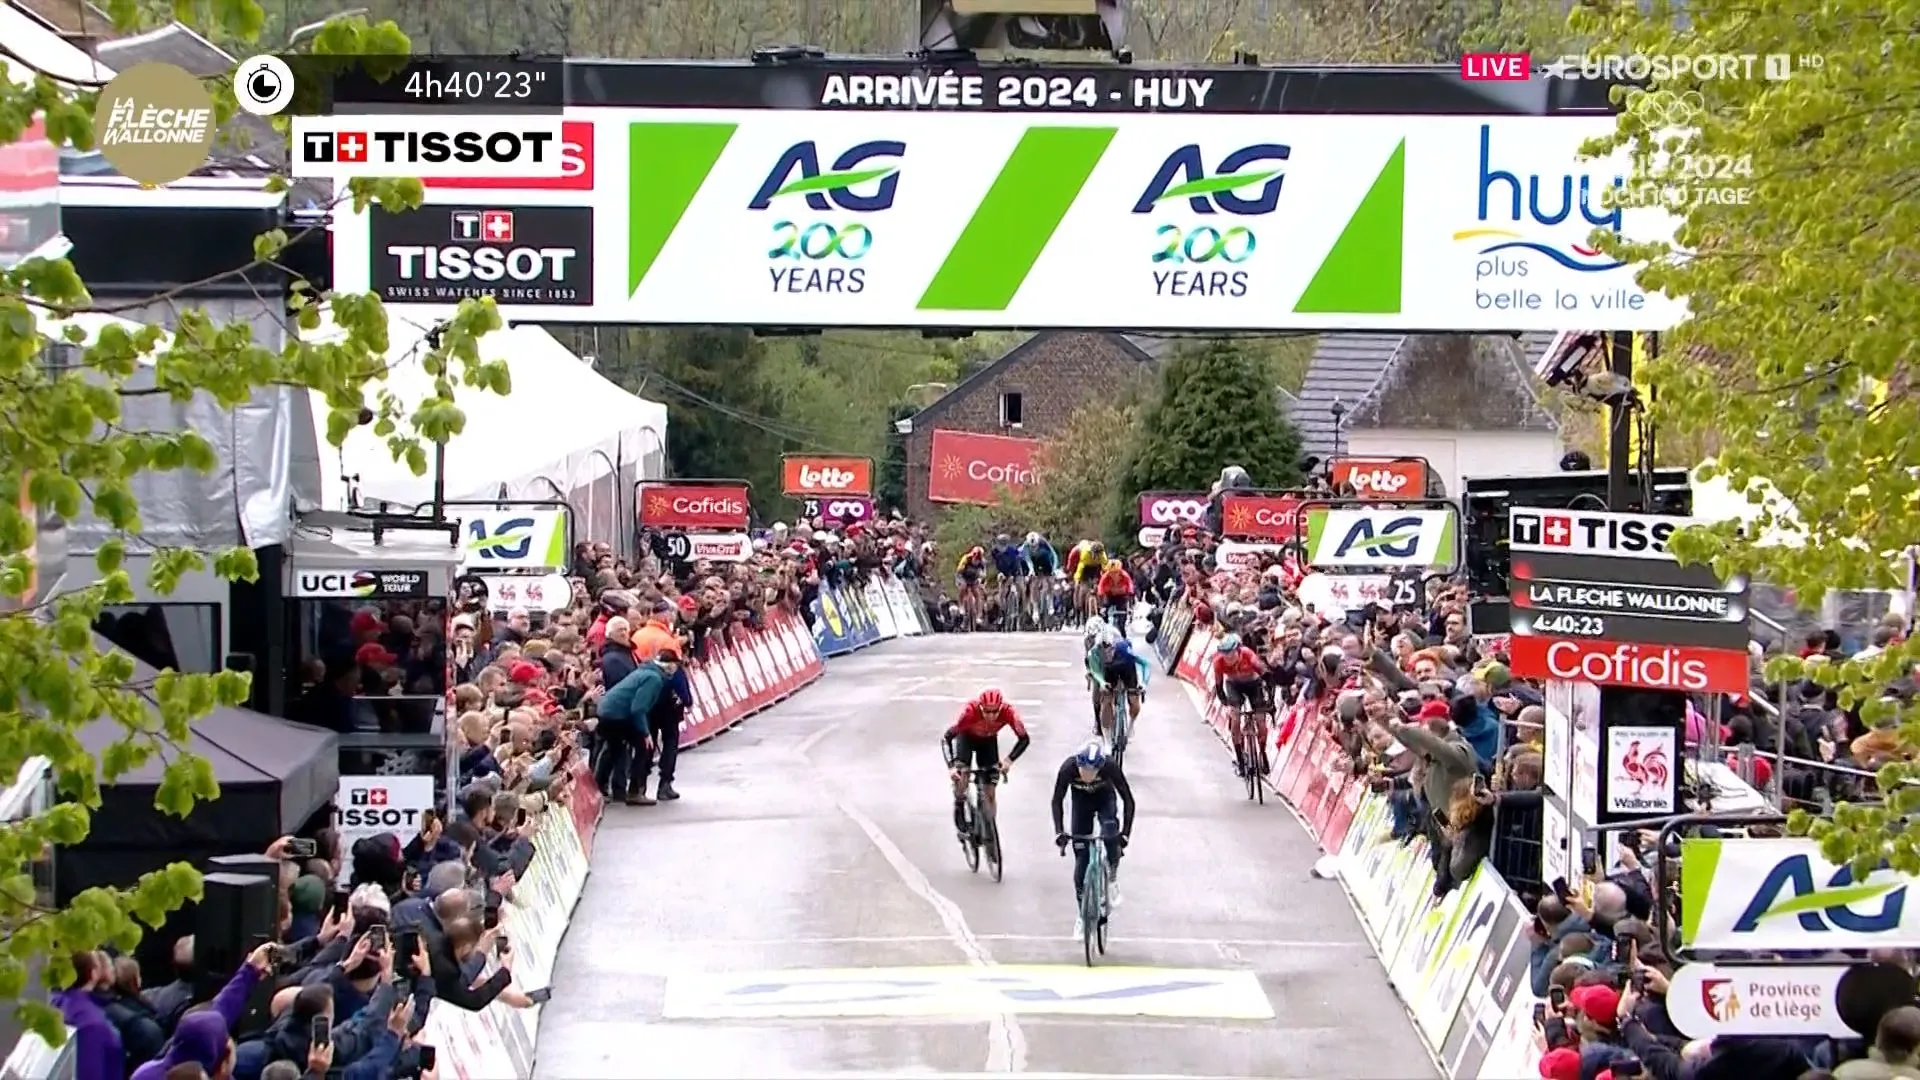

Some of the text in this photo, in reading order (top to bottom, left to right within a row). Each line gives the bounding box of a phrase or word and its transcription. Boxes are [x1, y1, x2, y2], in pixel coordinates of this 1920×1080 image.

[821, 70, 1214, 108] ARRIVÉE 2024 - HUY
[747, 139, 906, 212] AG
[1131, 142, 1291, 215] AG
[1477, 123, 1622, 243] huy
[768, 219, 873, 260] 200
[1151, 224, 1256, 264] 200
[387, 245, 576, 281] TISSOT
[1476, 255, 1528, 281] plus
[769, 266, 865, 293] YEARS
[1152, 270, 1249, 297] YEARS
[388, 287, 576, 299] SWISS WATCHES SINCE 1853
[1476, 287, 1644, 310] belle la ville
[673, 497, 743, 514] Cofidis
[804, 500, 819, 516] 75
[667, 536, 685, 557] 50
[1333, 516, 1423, 558] AG
[1579, 518, 1676, 552] TISS
[302, 575, 346, 592] UCI
[381, 574, 420, 584] WORLD
[383, 584, 412, 593] TOUR
[1394, 579, 1416, 604] 25
[1530, 585, 1728, 614] LA FLECHE WALLONNE
[1547, 641, 1708, 689] Cofidis
[1614, 797, 1668, 809] Wallonie
[338, 808, 419, 827] ISSOT
[1732, 853, 1908, 933] AG
[1749, 982, 1822, 997] Province
[1750, 1001, 1822, 1021] de Liège
